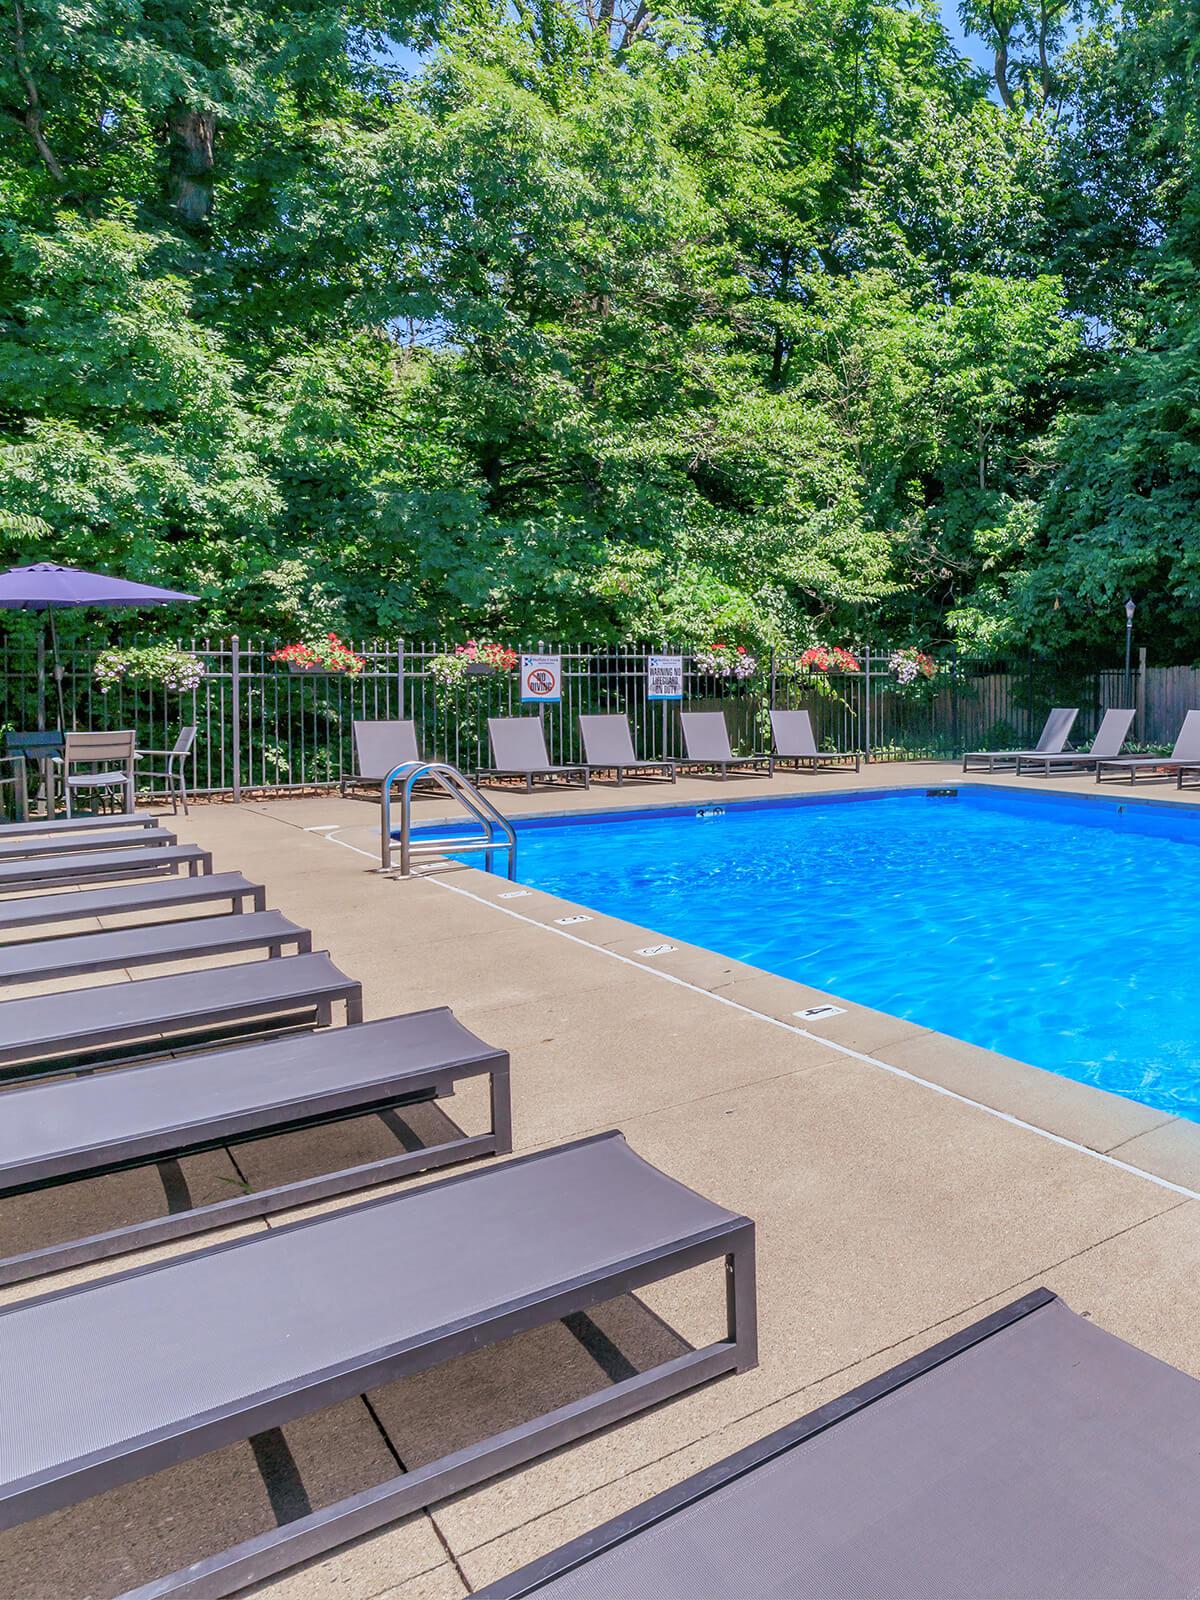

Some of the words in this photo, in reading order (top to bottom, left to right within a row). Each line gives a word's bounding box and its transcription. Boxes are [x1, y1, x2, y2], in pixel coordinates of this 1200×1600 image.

[537, 672, 546, 681] NO
[650, 668, 673, 676] WARNING
[674, 668, 681, 676] NO
[531, 682, 552, 691] DIVING
[655, 685, 663, 694] ON
[664, 685, 678, 694] DUTY
